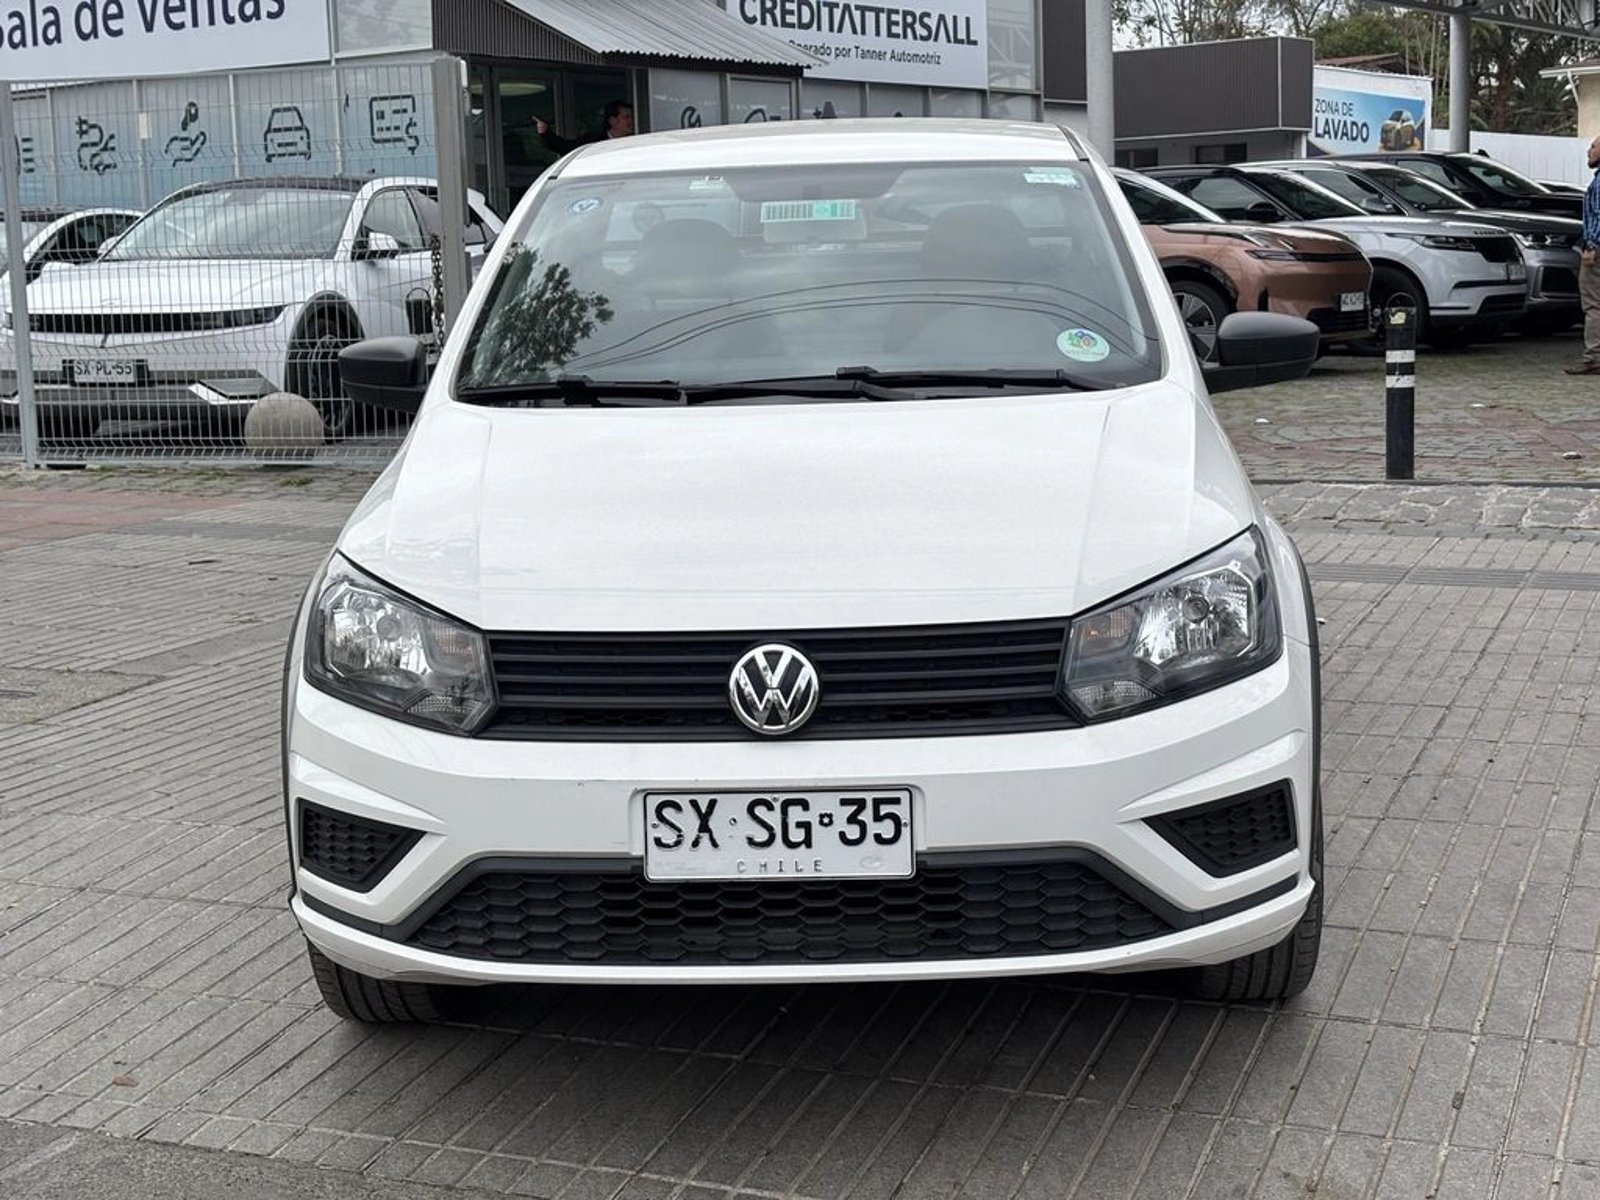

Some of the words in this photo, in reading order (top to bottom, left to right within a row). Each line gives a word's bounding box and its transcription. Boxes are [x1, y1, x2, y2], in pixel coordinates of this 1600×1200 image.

[74, 0, 124, 41] de
[739, 0, 979, 46] CREDITATTERSALL
[834, 46, 851, 59] por
[854, 45, 887, 62] Tanner
[889, 49, 942, 66] Automotriz
[1314, 98, 1340, 116] ZONA
[1341, 102, 1354, 117] DE
[1314, 116, 1370, 143] LAVADO
[736, 859, 824, 874] CHILE
